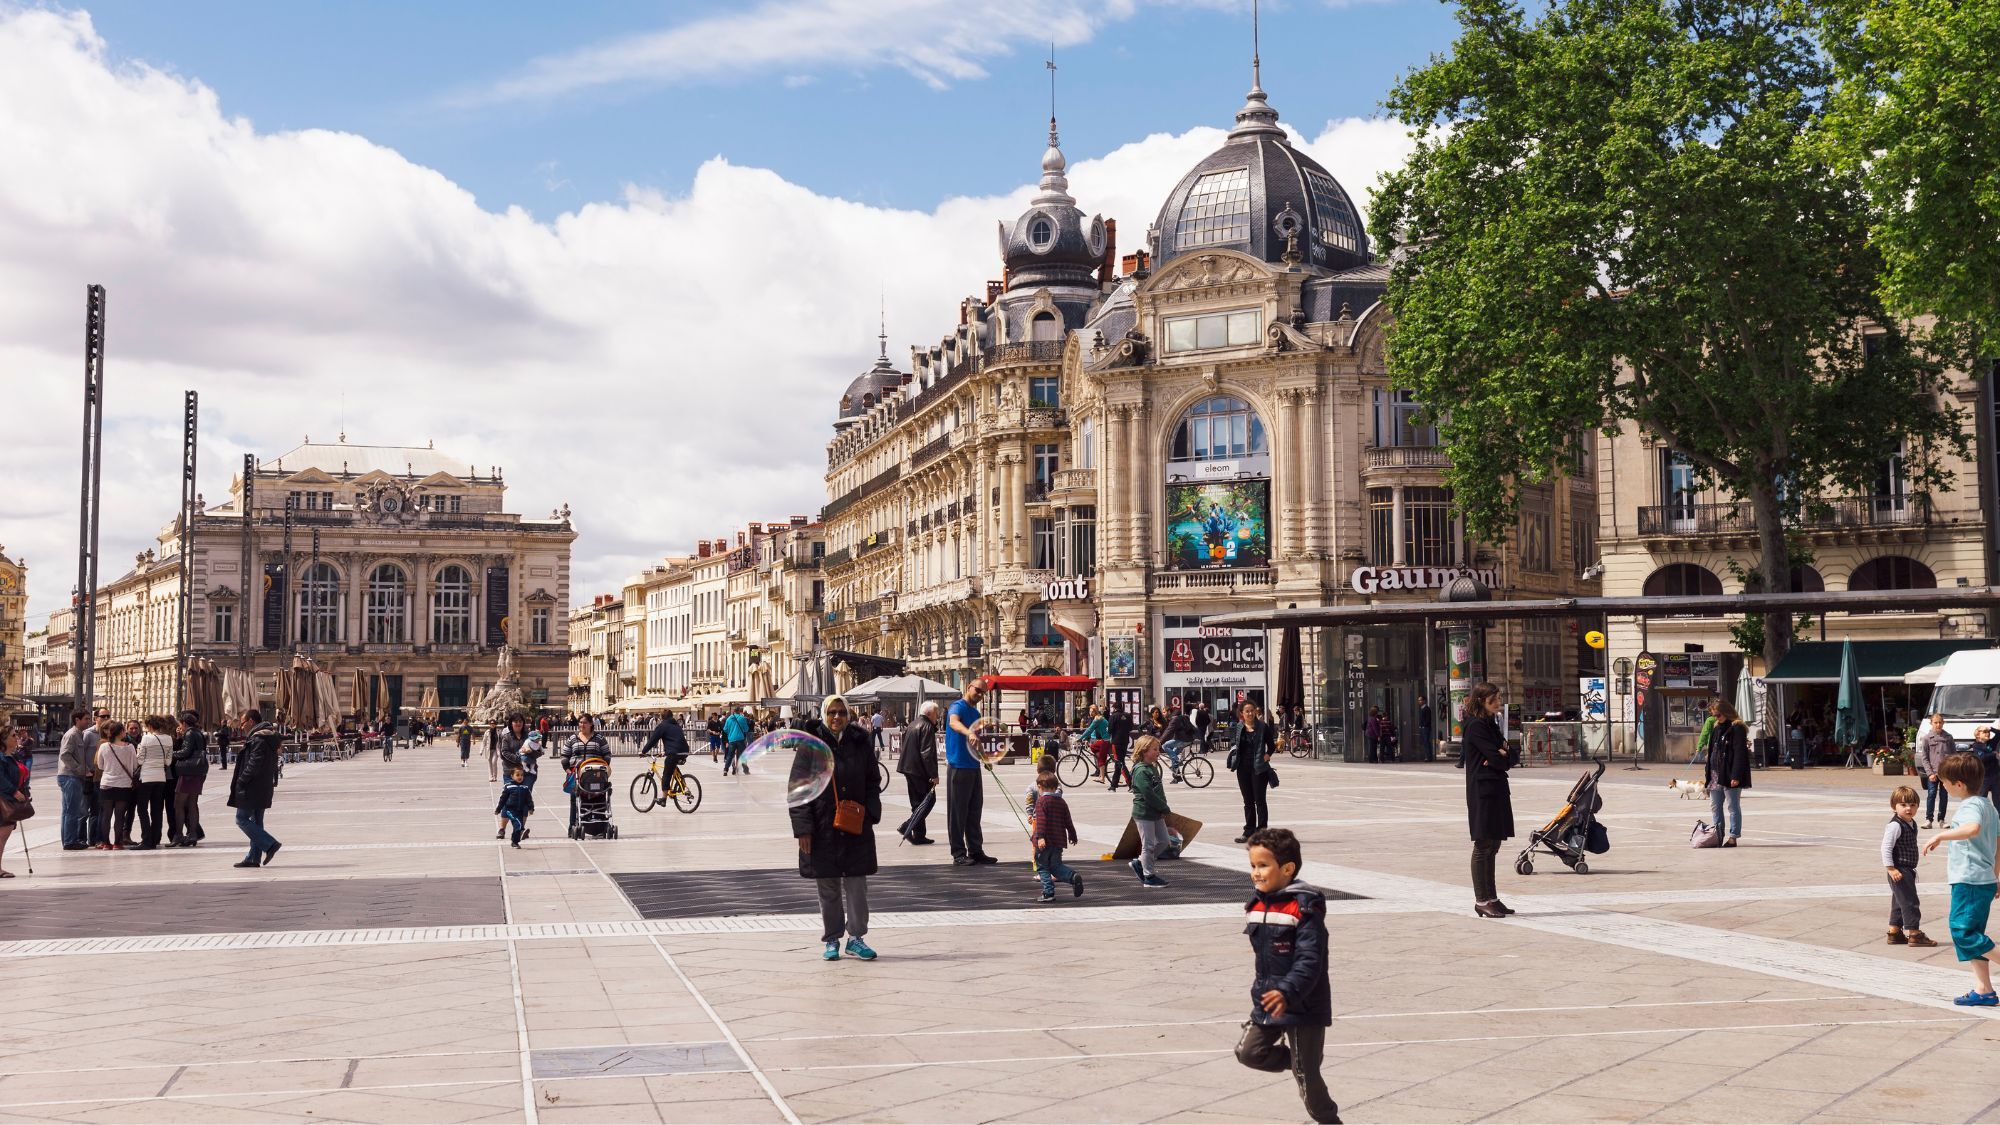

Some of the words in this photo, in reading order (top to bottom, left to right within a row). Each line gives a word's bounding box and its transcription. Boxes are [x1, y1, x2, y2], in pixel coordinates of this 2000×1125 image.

[1203, 642, 1264, 665] Quick
[1172, 697, 1180, 708] Q
[981, 737, 1015, 752] uick
